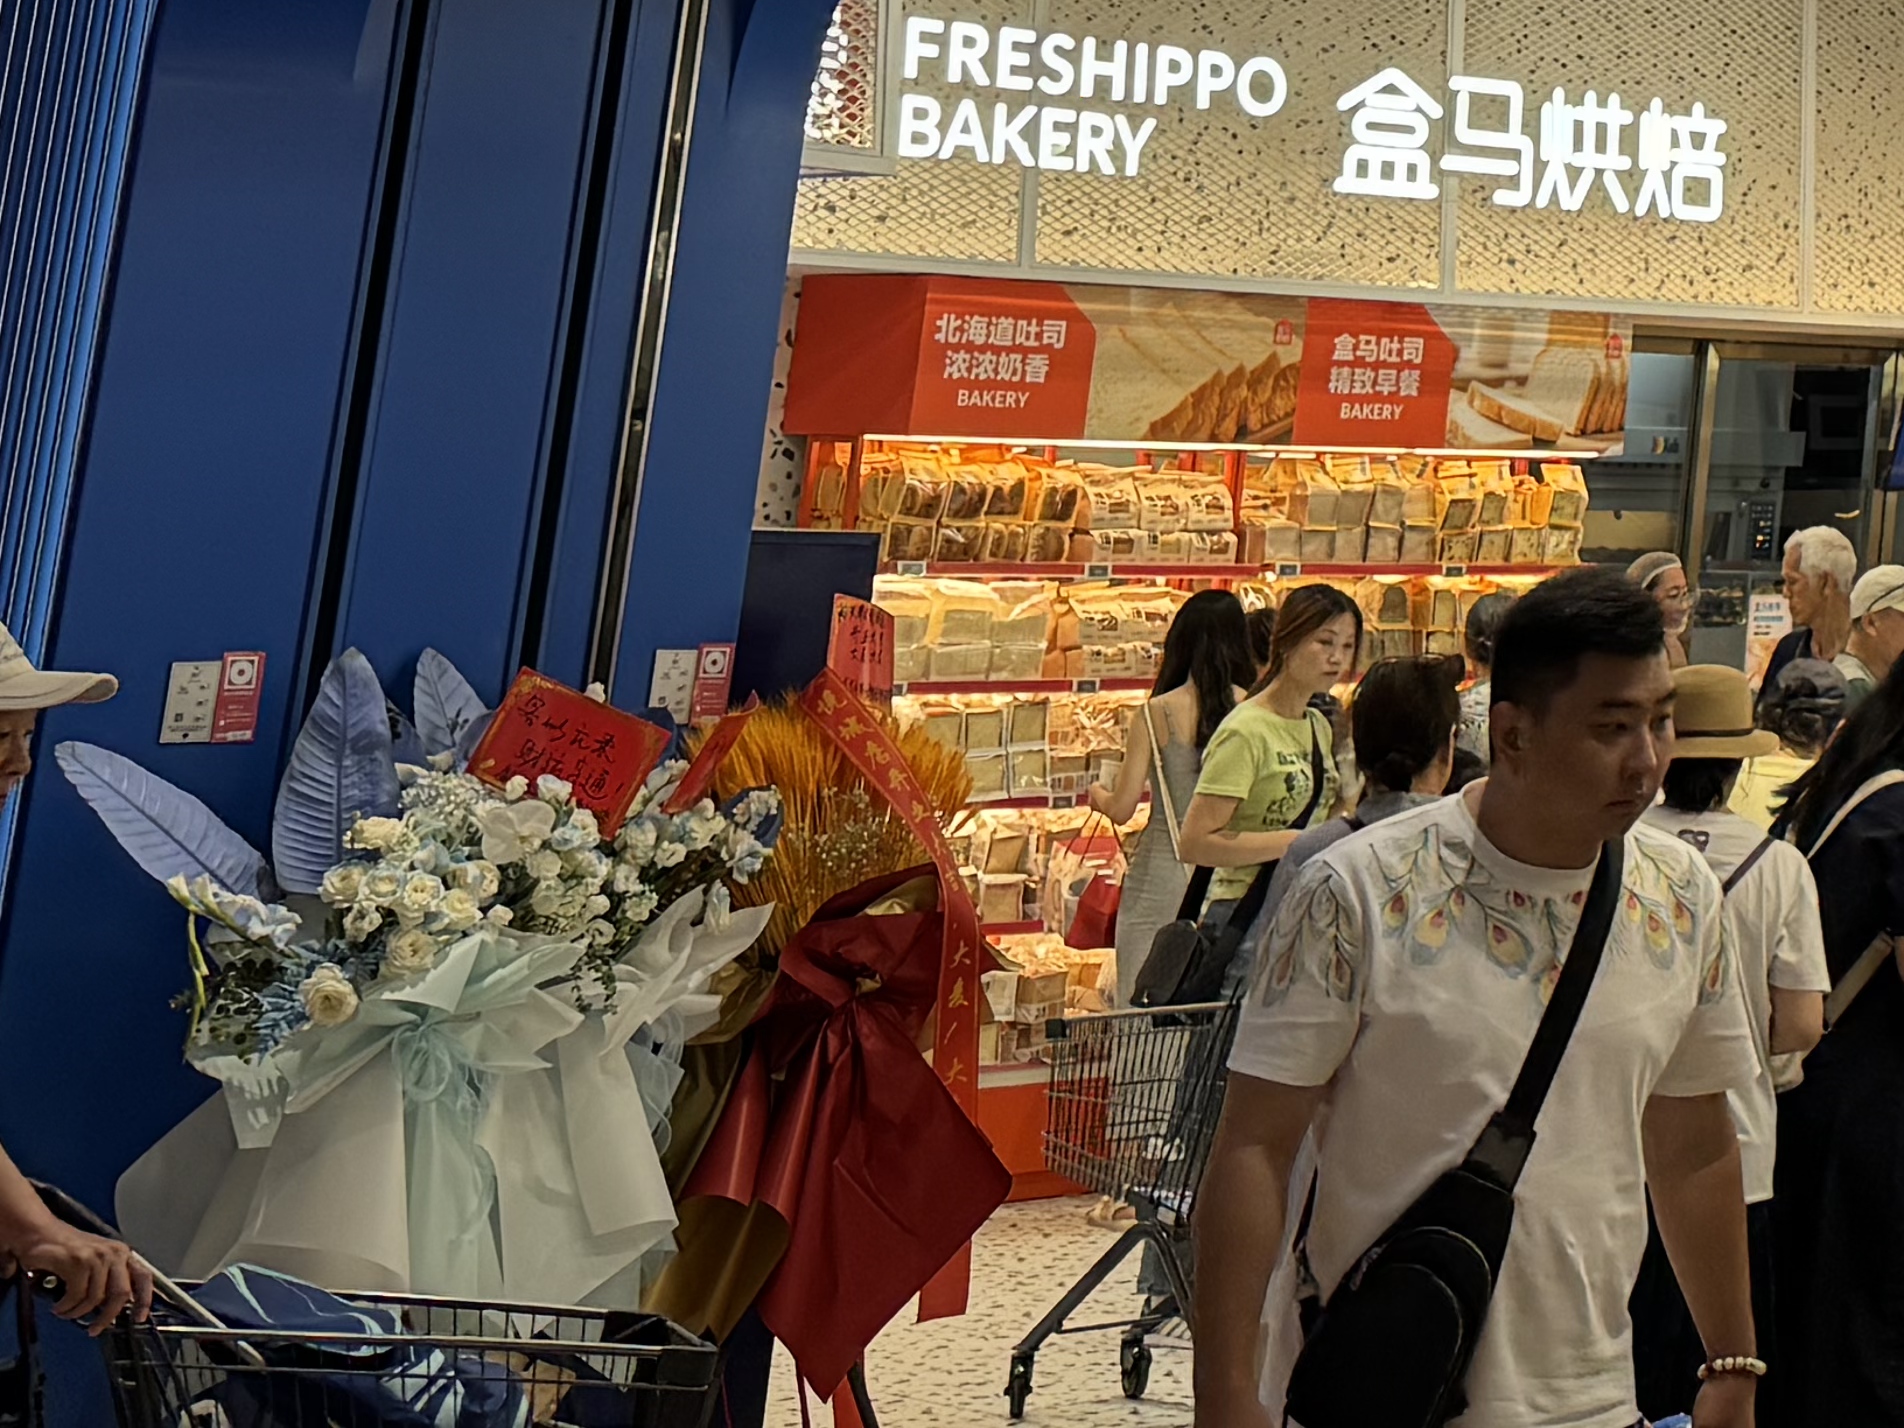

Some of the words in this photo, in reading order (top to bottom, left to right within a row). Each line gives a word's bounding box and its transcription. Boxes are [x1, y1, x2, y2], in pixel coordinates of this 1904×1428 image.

[903, 15, 1288, 118] FRESHIPPO
[899, 94, 1158, 177] BAKERY
[1332, 66, 1728, 224] 盒马烘焙
[933, 312, 1067, 350] 北海道吐司
[1332, 332, 1425, 365] 盒马吐司
[942, 350, 1050, 384] 浓浓奶香
[1327, 366, 1421, 397] 精致早餐
[956, 389, 1031, 410] BAKERY
[1339, 402, 1404, 421] BAKERY
